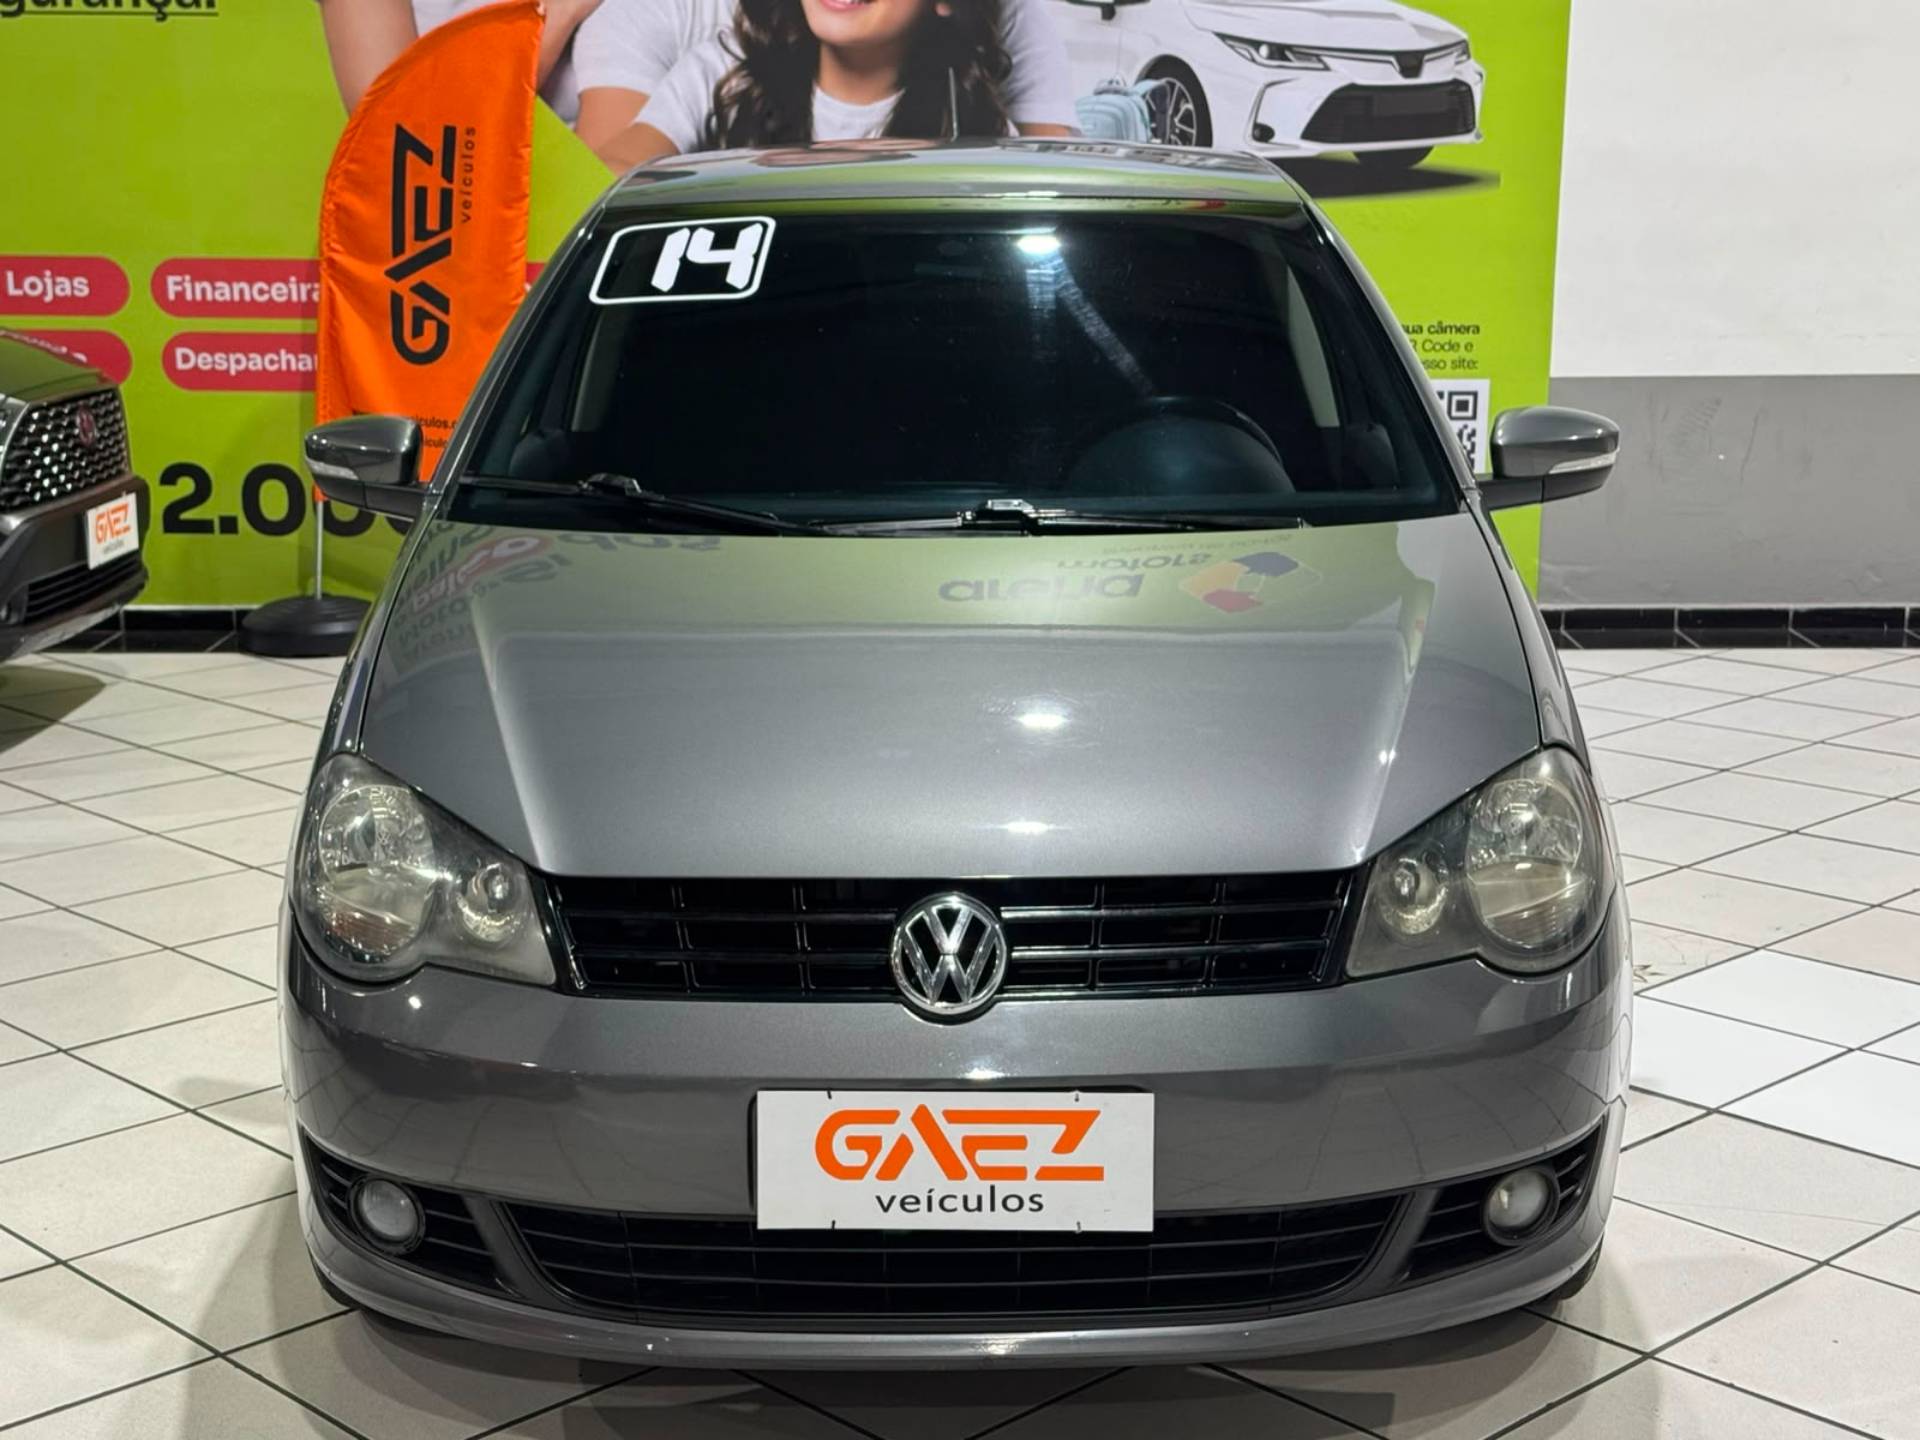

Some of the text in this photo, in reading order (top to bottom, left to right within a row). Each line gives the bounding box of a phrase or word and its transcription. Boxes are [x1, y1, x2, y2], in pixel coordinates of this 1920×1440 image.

[384, 123, 457, 366] GAEZ
[651, 222, 764, 293] 14
[6, 269, 91, 304] Lojas
[1427, 320, 1480, 335] câmera
[174, 347, 318, 376] Despacha
[1421, 338, 1460, 353] Code
[1464, 341, 1474, 353] e
[1451, 355, 1479, 370] site:
[159, 461, 412, 537] 2.0
[814, 1103, 1105, 1181] GAEZ
[875, 1184, 1045, 1213] veículos
